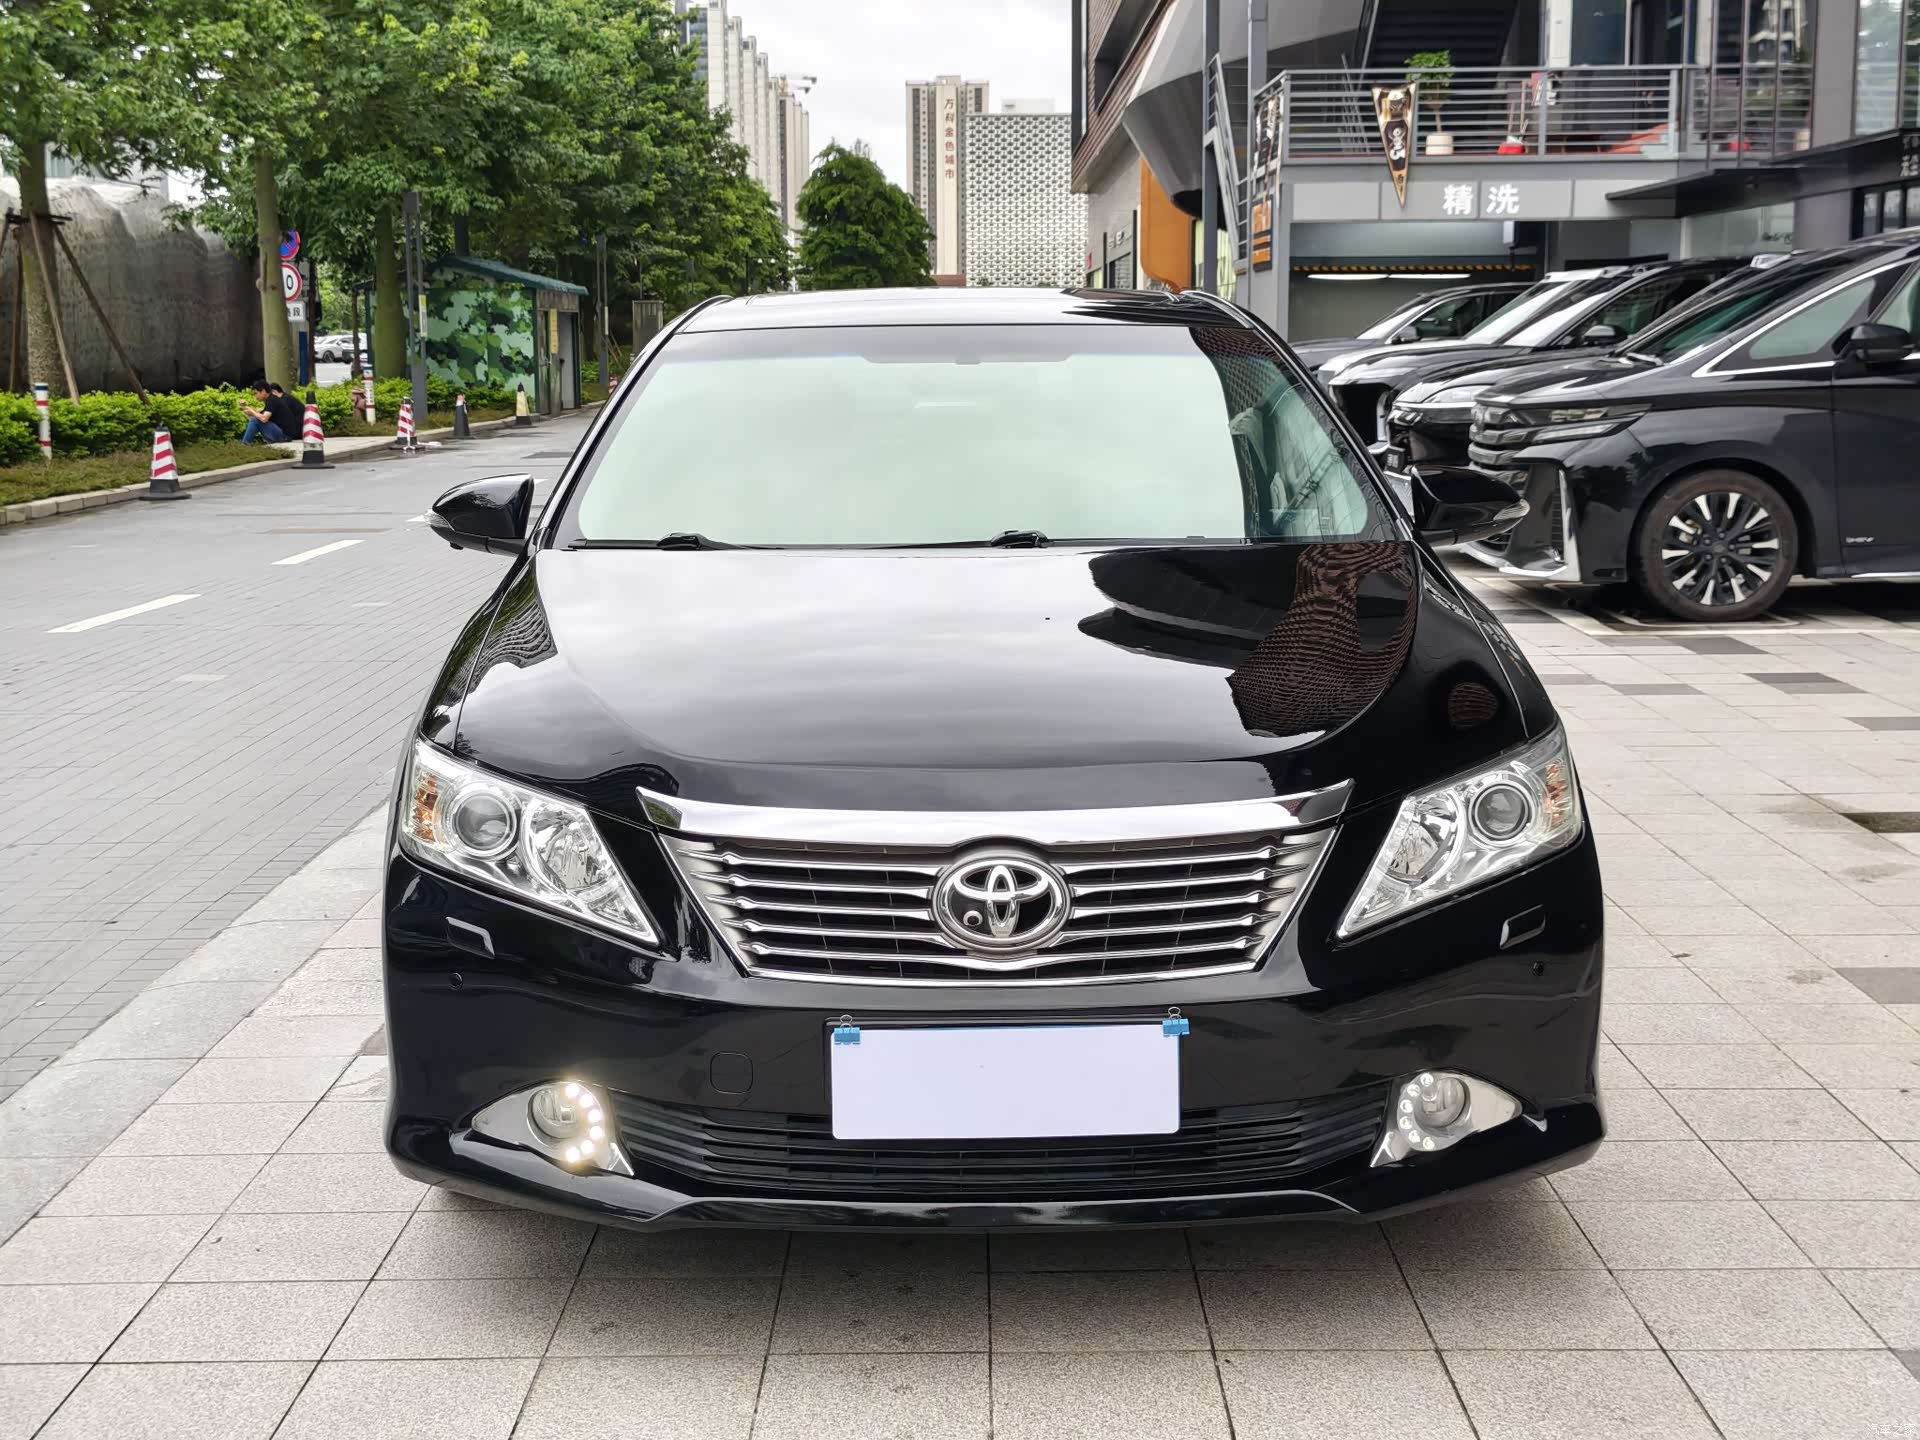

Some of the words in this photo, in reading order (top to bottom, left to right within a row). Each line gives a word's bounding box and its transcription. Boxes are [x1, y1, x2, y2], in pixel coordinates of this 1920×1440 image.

[944, 98, 955, 179] 万科金色城市
[1442, 183, 1520, 216] 精洗
